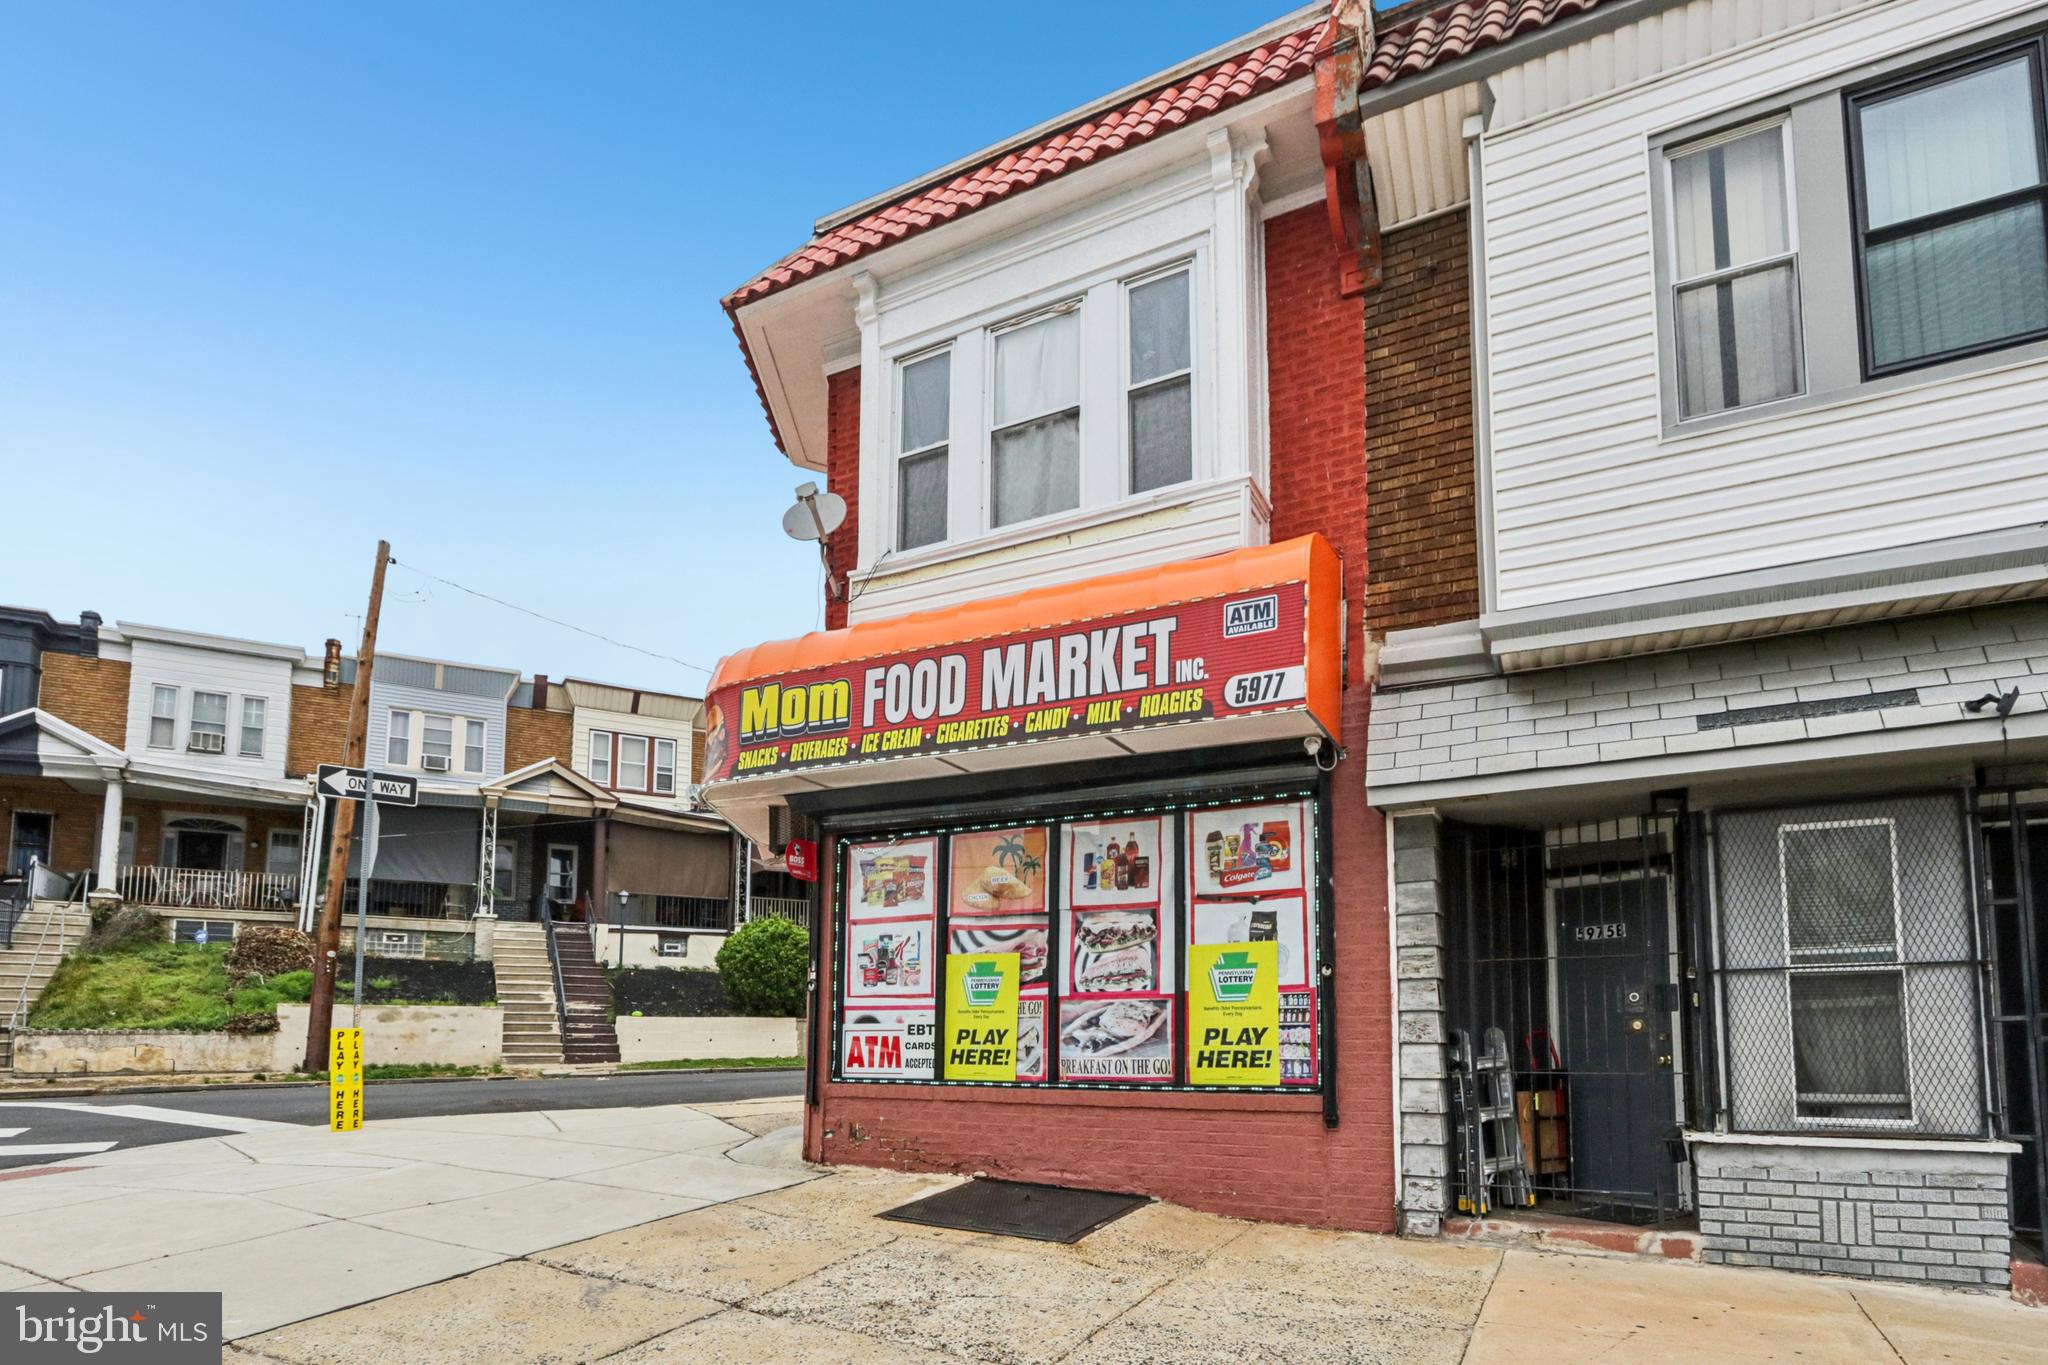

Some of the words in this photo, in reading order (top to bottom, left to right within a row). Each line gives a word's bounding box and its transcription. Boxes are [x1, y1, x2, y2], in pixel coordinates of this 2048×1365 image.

[1229, 601, 1271, 625] ATM
[1228, 620, 1274, 634] AVAILABLE
[741, 680, 850, 743] Mom
[863, 653, 967, 728] FOOD
[981, 617, 1177, 712] MARKET
[1175, 658, 1209, 684] INC.
[1234, 672, 1286, 704] 5977
[738, 747, 779, 770] SNACKS
[790, 737, 849, 762] BEVERAGES
[861, 733, 880, 754] ICE
[881, 727, 922, 751] CREAM
[936, 715, 1010, 744] CIGARETTES
[1025, 707, 1071, 733] CANDY
[1086, 700, 1122, 725] MILK
[1140, 688, 1204, 718] HOAGIES
[348, 777, 374, 792] ON
[380, 781, 407, 795] WAY
[1224, 872, 1255, 882] Colgate
[1218, 975, 1254, 984] LOTTERY
[1028, 1001, 1042, 1015] GO!
[907, 1024, 936, 1036] EBT
[956, 1029, 1009, 1046] PLAY
[1203, 1027, 1269, 1046] PLAY
[336, 1031, 345, 1070] PLAY
[847, 1036, 902, 1069] ATM
[905, 1042, 936, 1050] CARDS
[950, 1048, 1011, 1066] HERE!
[1196, 1050, 1273, 1069] HERE!
[1114, 1058, 1129, 1075] ON
[1131, 1058, 1151, 1075] THE
[1153, 1058, 1171, 1075] GO!
[336, 1090, 345, 1130] HERE
